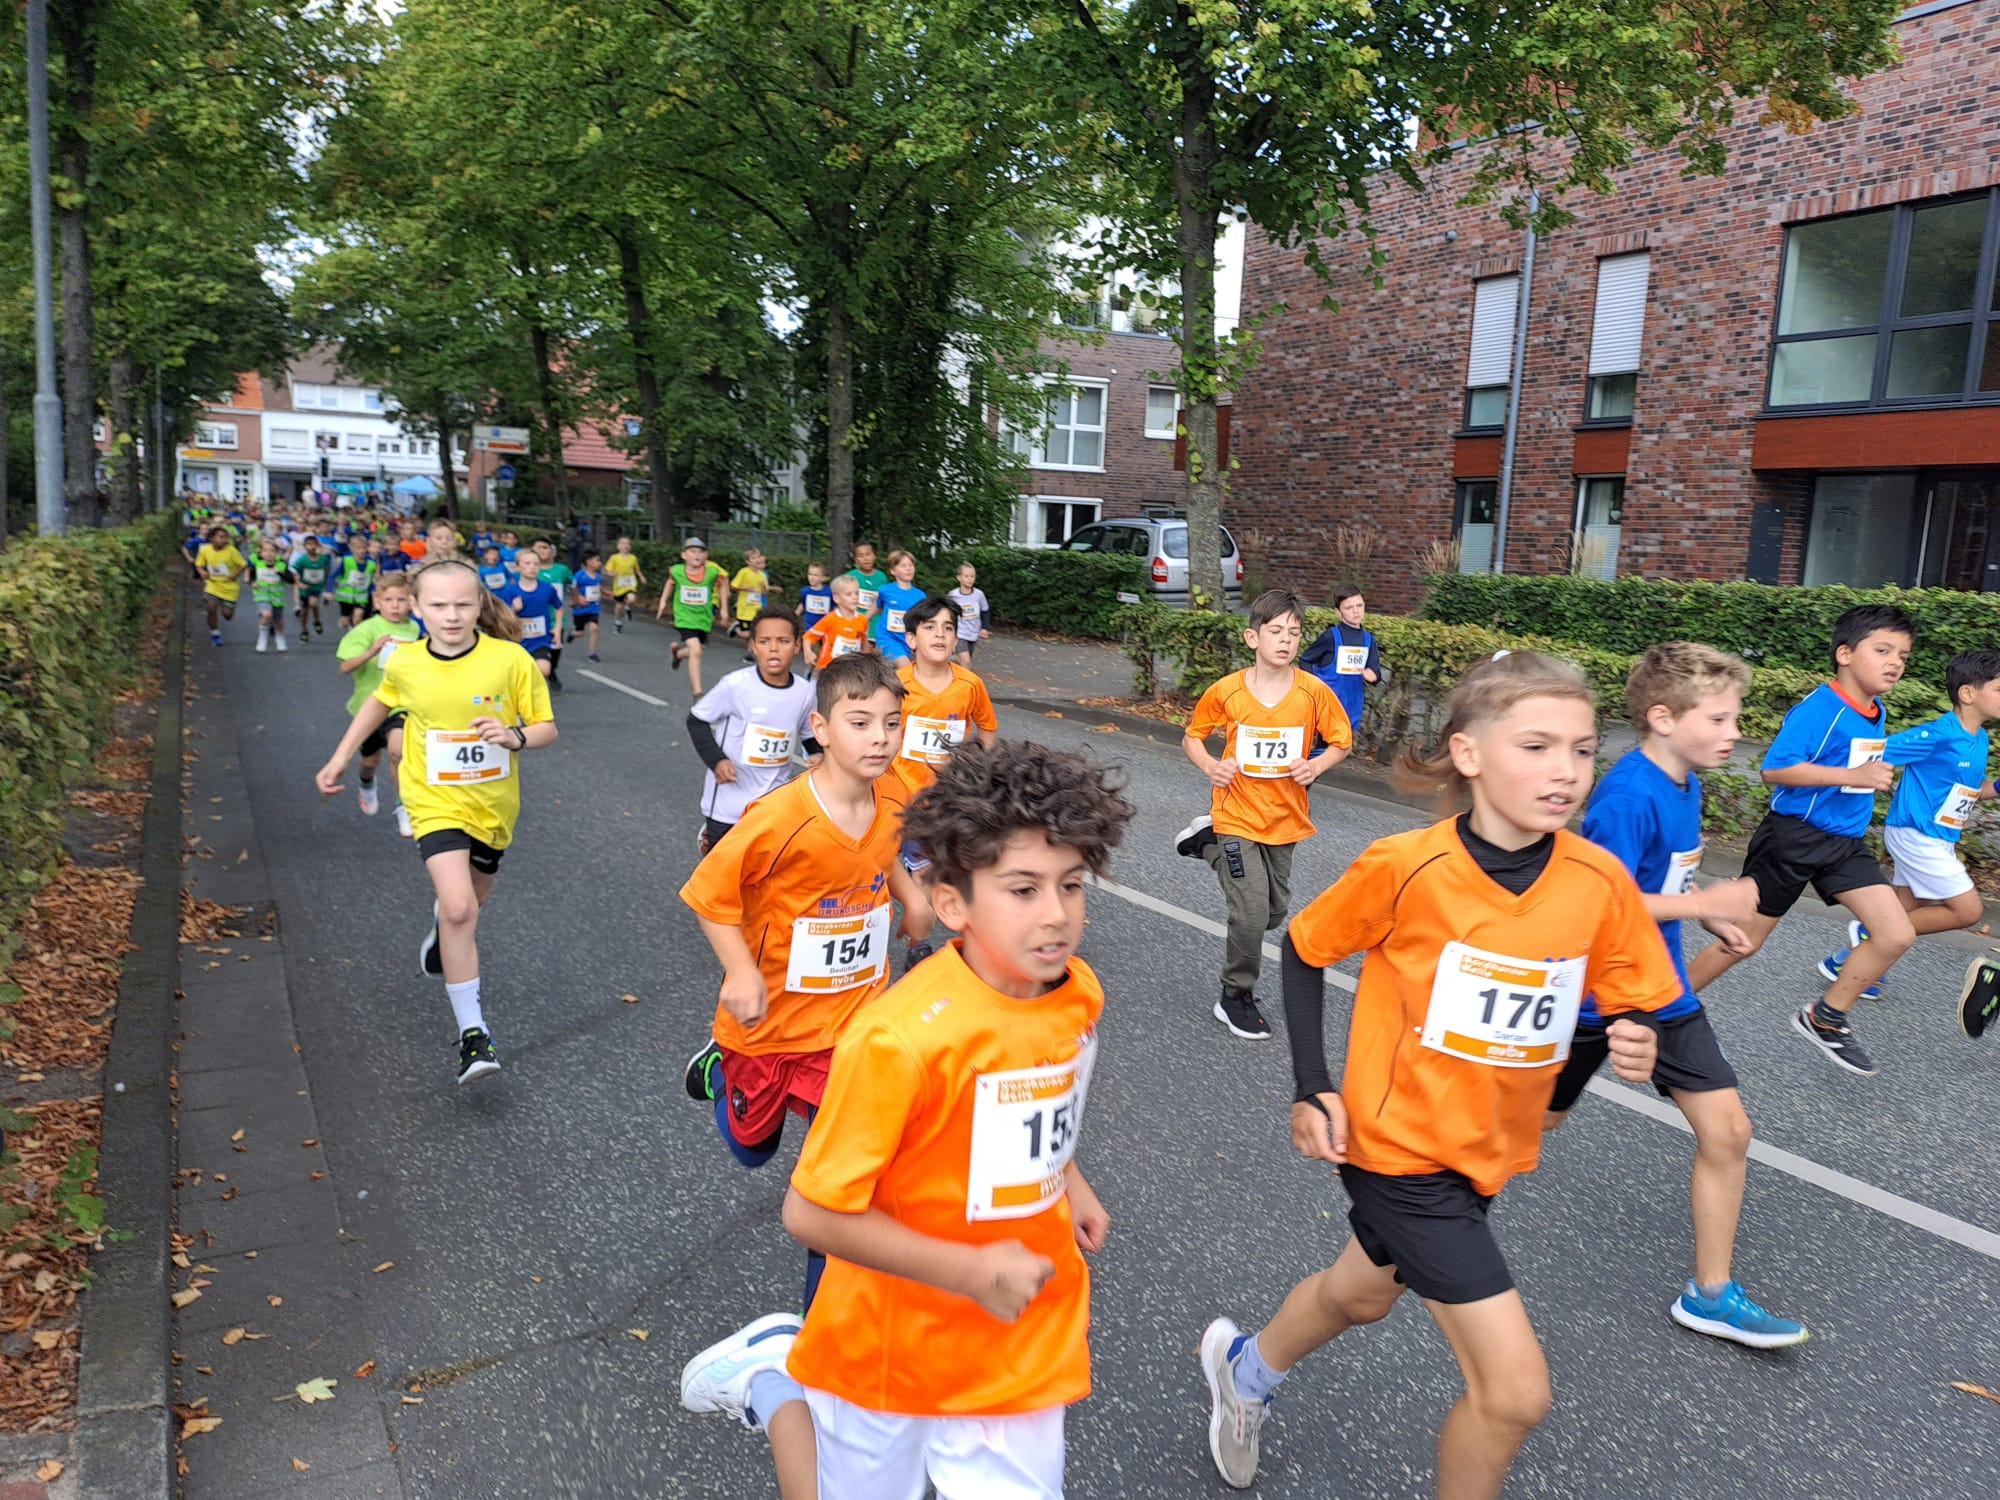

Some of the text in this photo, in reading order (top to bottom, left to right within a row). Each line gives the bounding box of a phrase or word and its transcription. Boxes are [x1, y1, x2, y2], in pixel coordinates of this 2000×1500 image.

[455, 745, 485, 764] 46
[758, 738, 790, 753] 313
[1253, 741, 1288, 759] 173
[821, 933, 871, 966] 154
[1479, 988, 1557, 1031] 176
